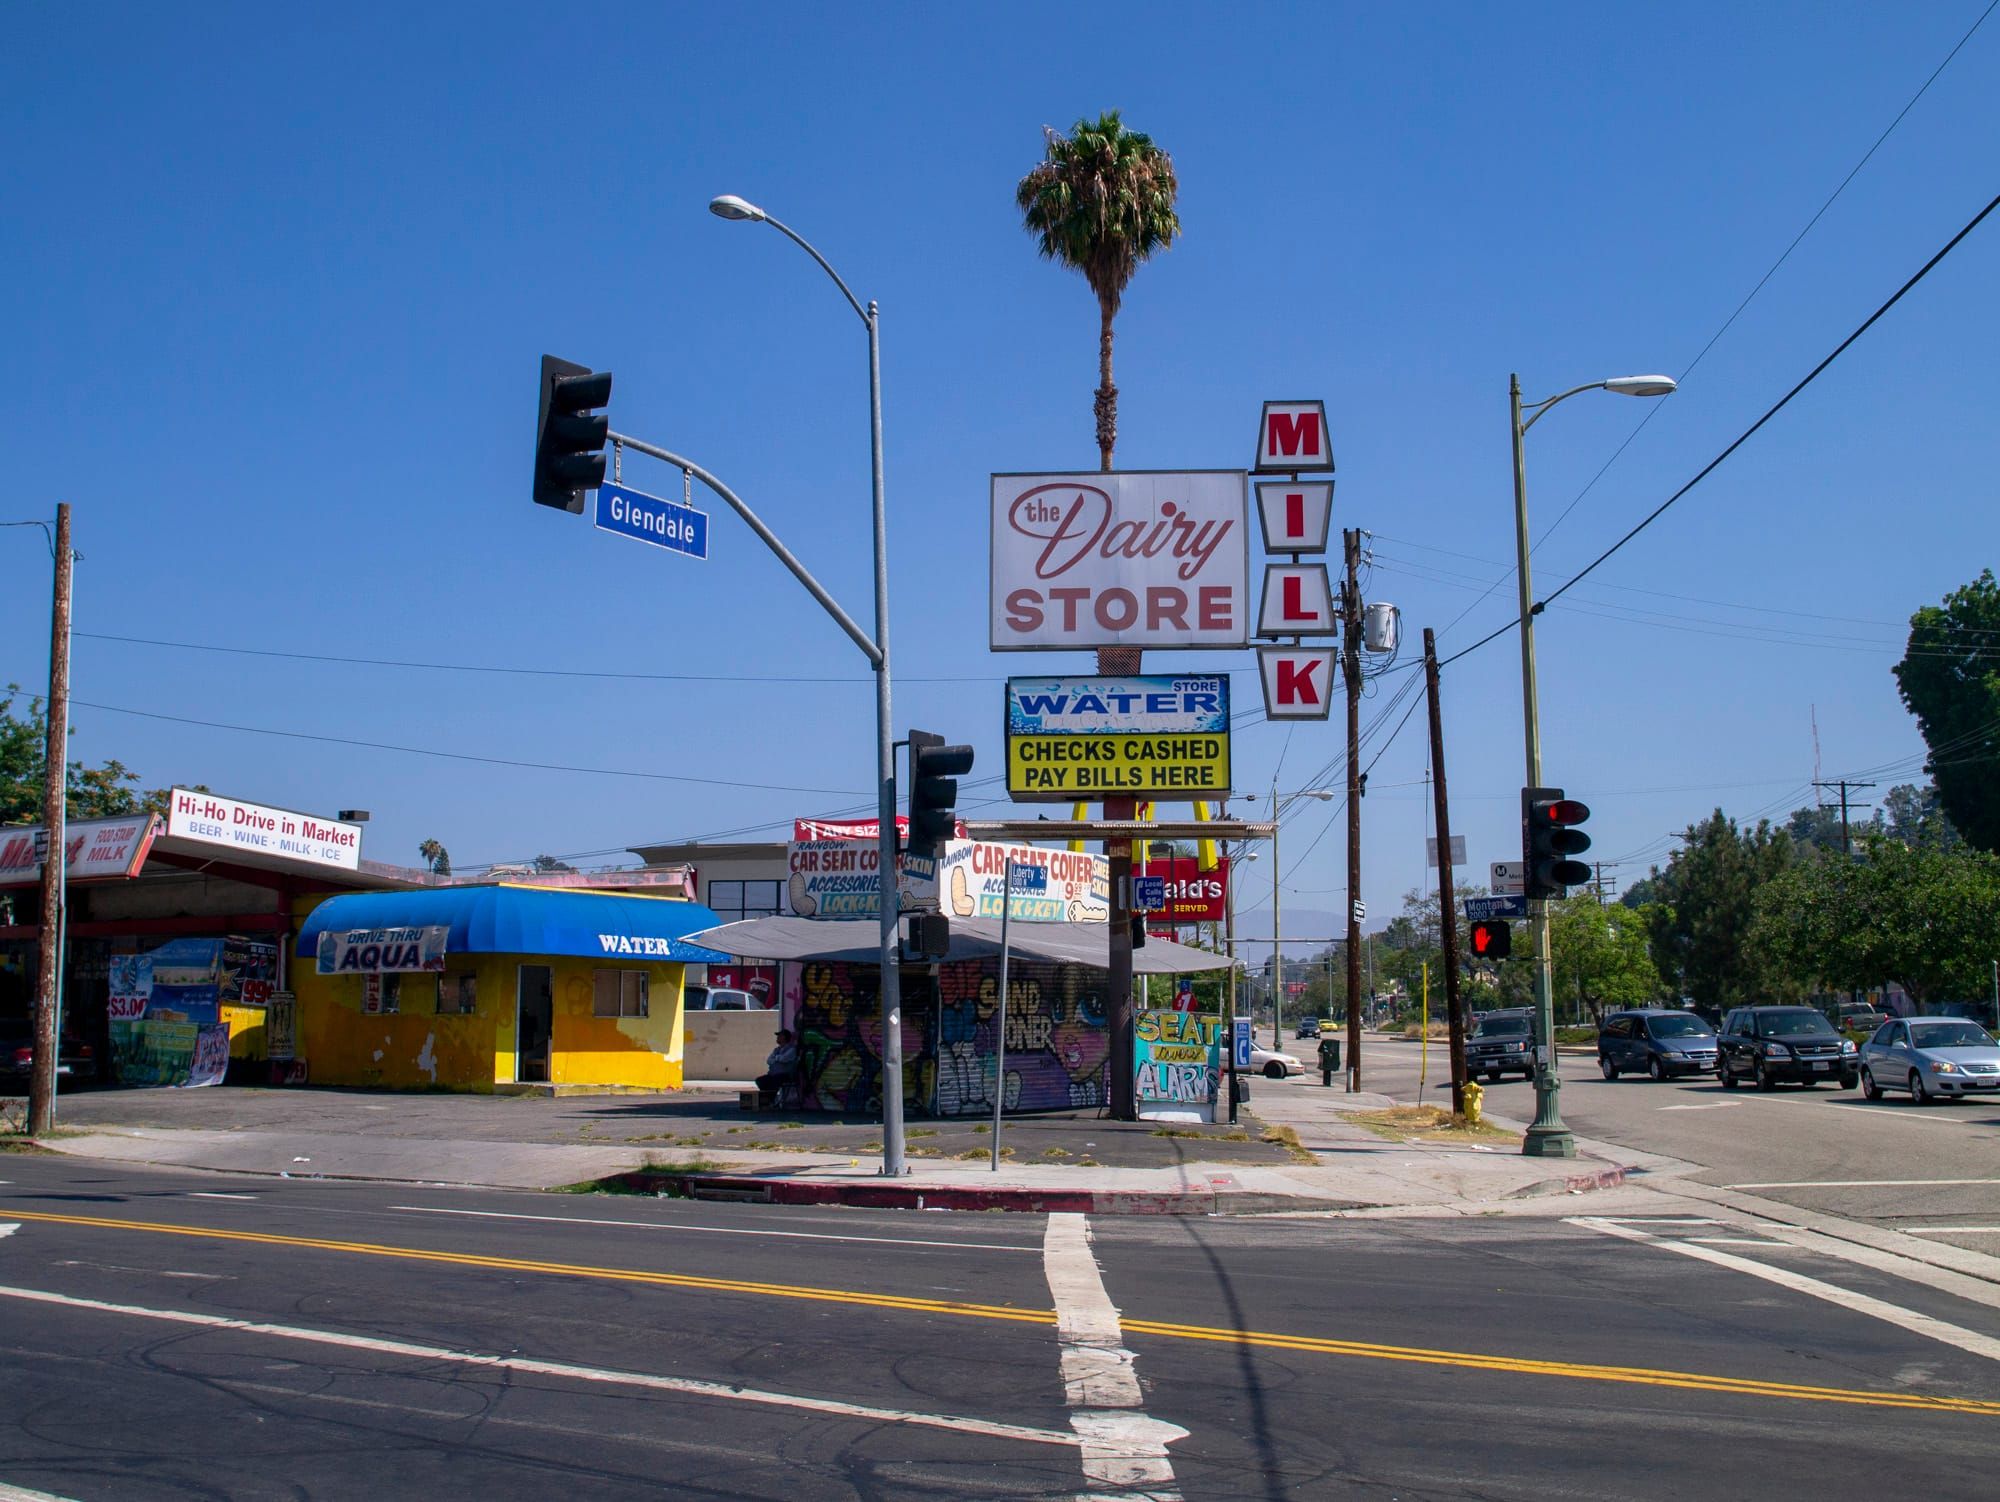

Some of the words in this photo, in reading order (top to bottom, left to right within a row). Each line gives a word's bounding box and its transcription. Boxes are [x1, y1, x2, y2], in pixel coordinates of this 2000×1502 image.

[611, 496, 695, 544] Glendale
[1024, 498, 1060, 523] the
[1008, 483, 1235, 580] Dairy
[1267, 412, 1324, 706] MILK
[1005, 586, 1233, 632] STORE
[1173, 681, 1219, 692] STORE
[1018, 693, 1220, 715] WATER
[1019, 740, 1116, 761] CHECKS
[1123, 739, 1220, 760] CASHED
[1025, 767, 1068, 787] PAY
[1076, 767, 1143, 787] BILLS
[1151, 766, 1214, 786] HERE
[178, 795, 226, 822] Hi-Ho
[233, 806, 276, 832] Drive
[281, 816, 296, 835] in
[302, 820, 355, 848] Market
[855, 825, 880, 837] SIZ
[189, 821, 222, 838] BEER
[234, 830, 268, 847] WINE
[280, 839, 311, 855] MILK
[321, 847, 341, 861] ICE
[798, 840, 846, 850] RAINBOW
[87, 846, 129, 862] MILK
[789, 850, 819, 873] CAR
[822, 849, 859, 872] SEAT
[972, 843, 1005, 875] CAR
[1050, 852, 1093, 884] COVER
[904, 855, 935, 876] SKIN
[1013, 865, 1035, 882] Liberty
[1039, 867, 1046, 880] St
[1468, 900, 1503, 912] Montan
[1468, 910, 1488, 919] 2000
[347, 930, 385, 945] DRIVE
[390, 929, 424, 942] THRU
[599, 934, 671, 956] WATER
[338, 943, 420, 971] AQUA
[1136, 1011, 1221, 1046] SEAT
[1135, 1060, 1220, 1102] ALARMS
